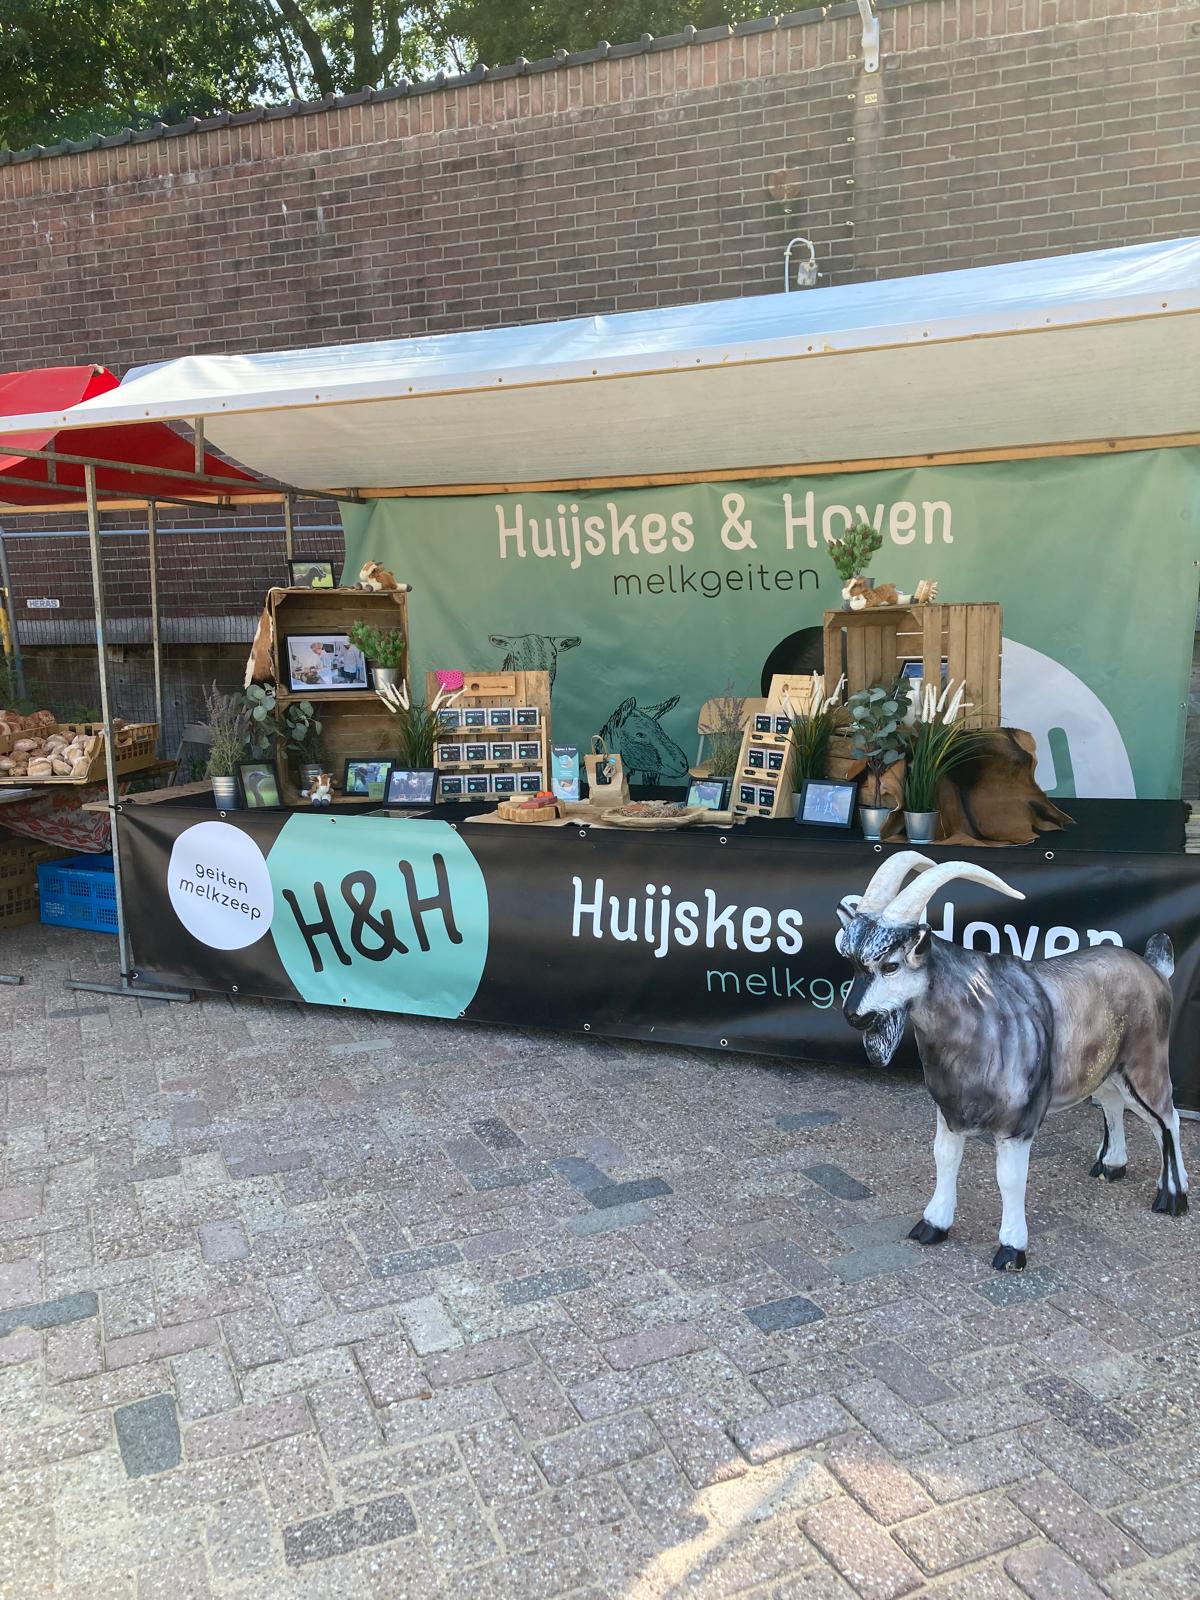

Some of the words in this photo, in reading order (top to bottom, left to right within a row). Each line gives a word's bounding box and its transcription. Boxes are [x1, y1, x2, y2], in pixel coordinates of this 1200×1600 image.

[495, 502, 694, 570] Huijskes
[720, 493, 757, 551] &
[782, 491, 954, 550] Hoven
[613, 563, 820, 598] melkgeiten
[30, 600, 58, 608] HERAS
[179, 877, 262, 921] melkzeep
[195, 863, 248, 894] geiten
[282, 852, 464, 972] H&H
[571, 876, 803, 958] Huijskes
